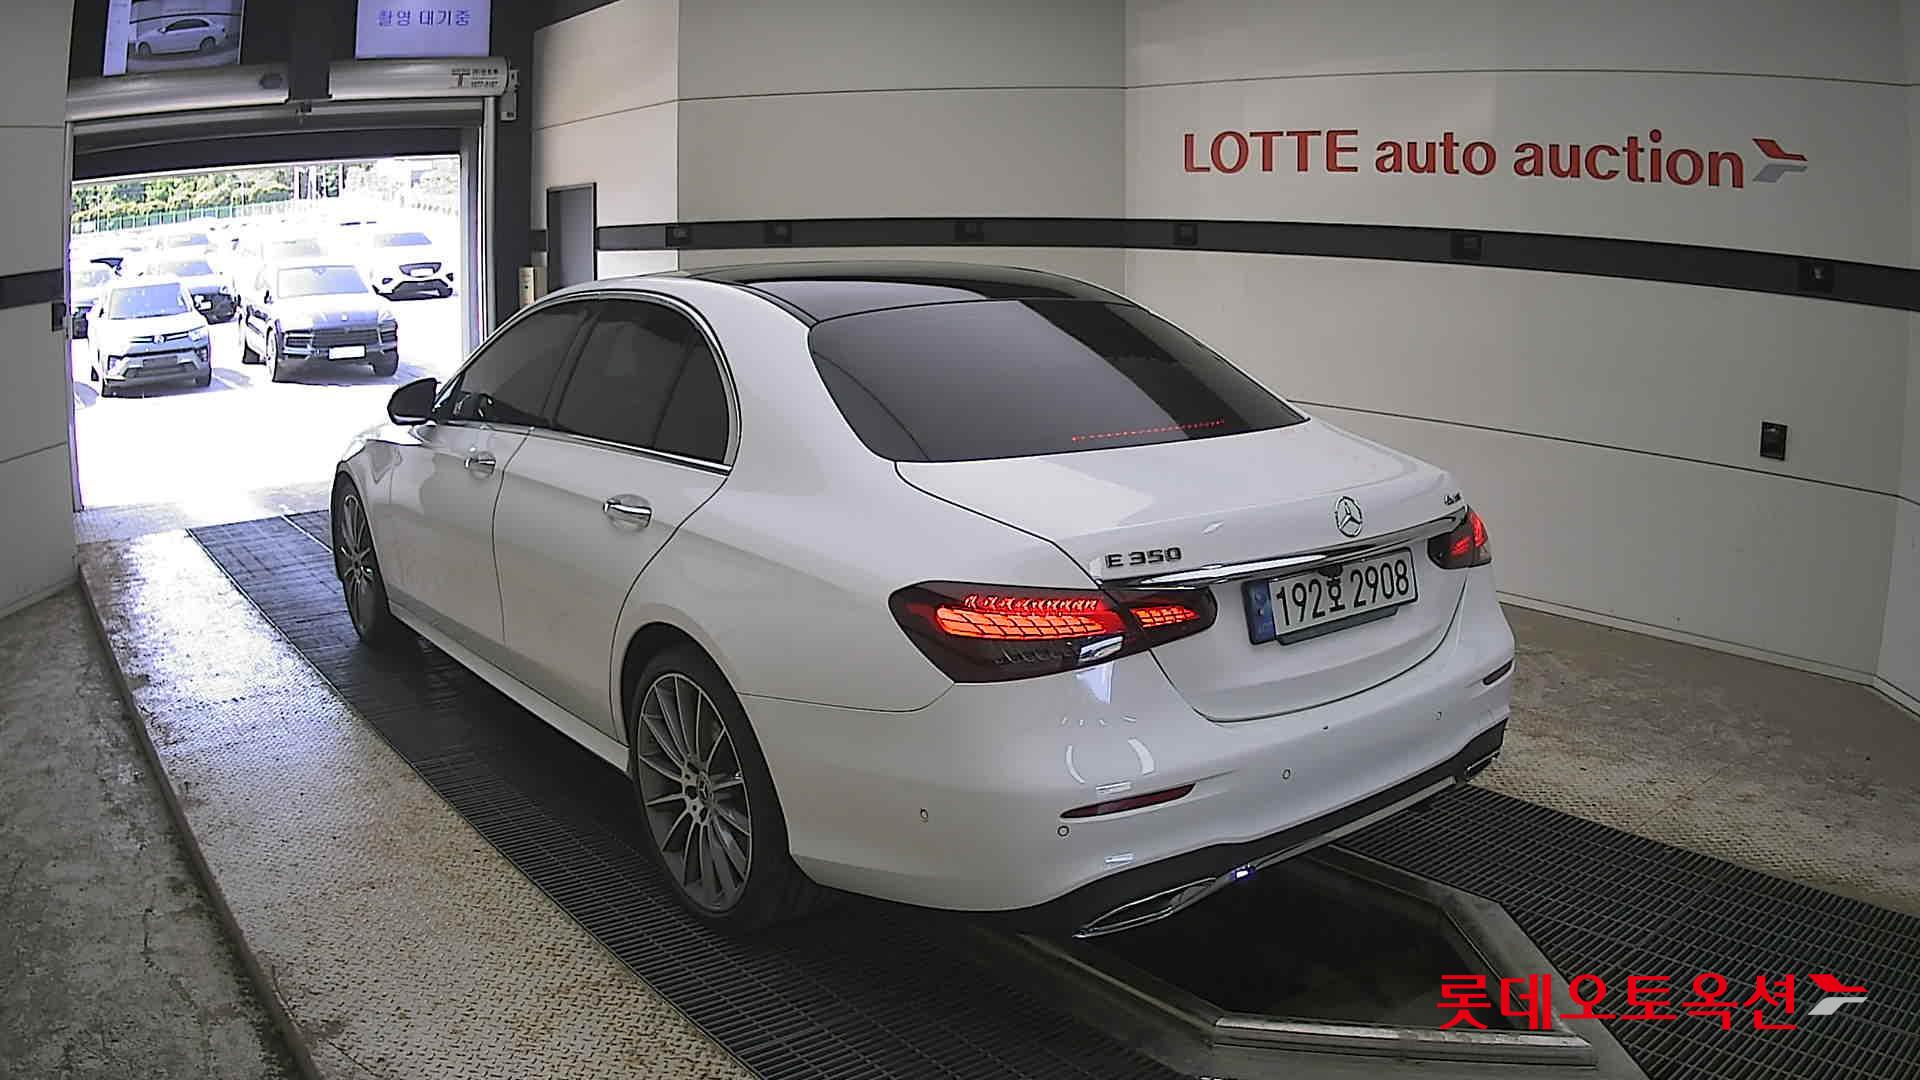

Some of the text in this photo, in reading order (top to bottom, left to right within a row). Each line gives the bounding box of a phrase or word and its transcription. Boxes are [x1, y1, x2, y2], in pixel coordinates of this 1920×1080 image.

[418, 9, 471, 26] 대기중
[1184, 128, 1744, 189] LOTTE auto auction
[1105, 547, 1182, 568] E 350
[1350, 559, 1409, 608] 2908
